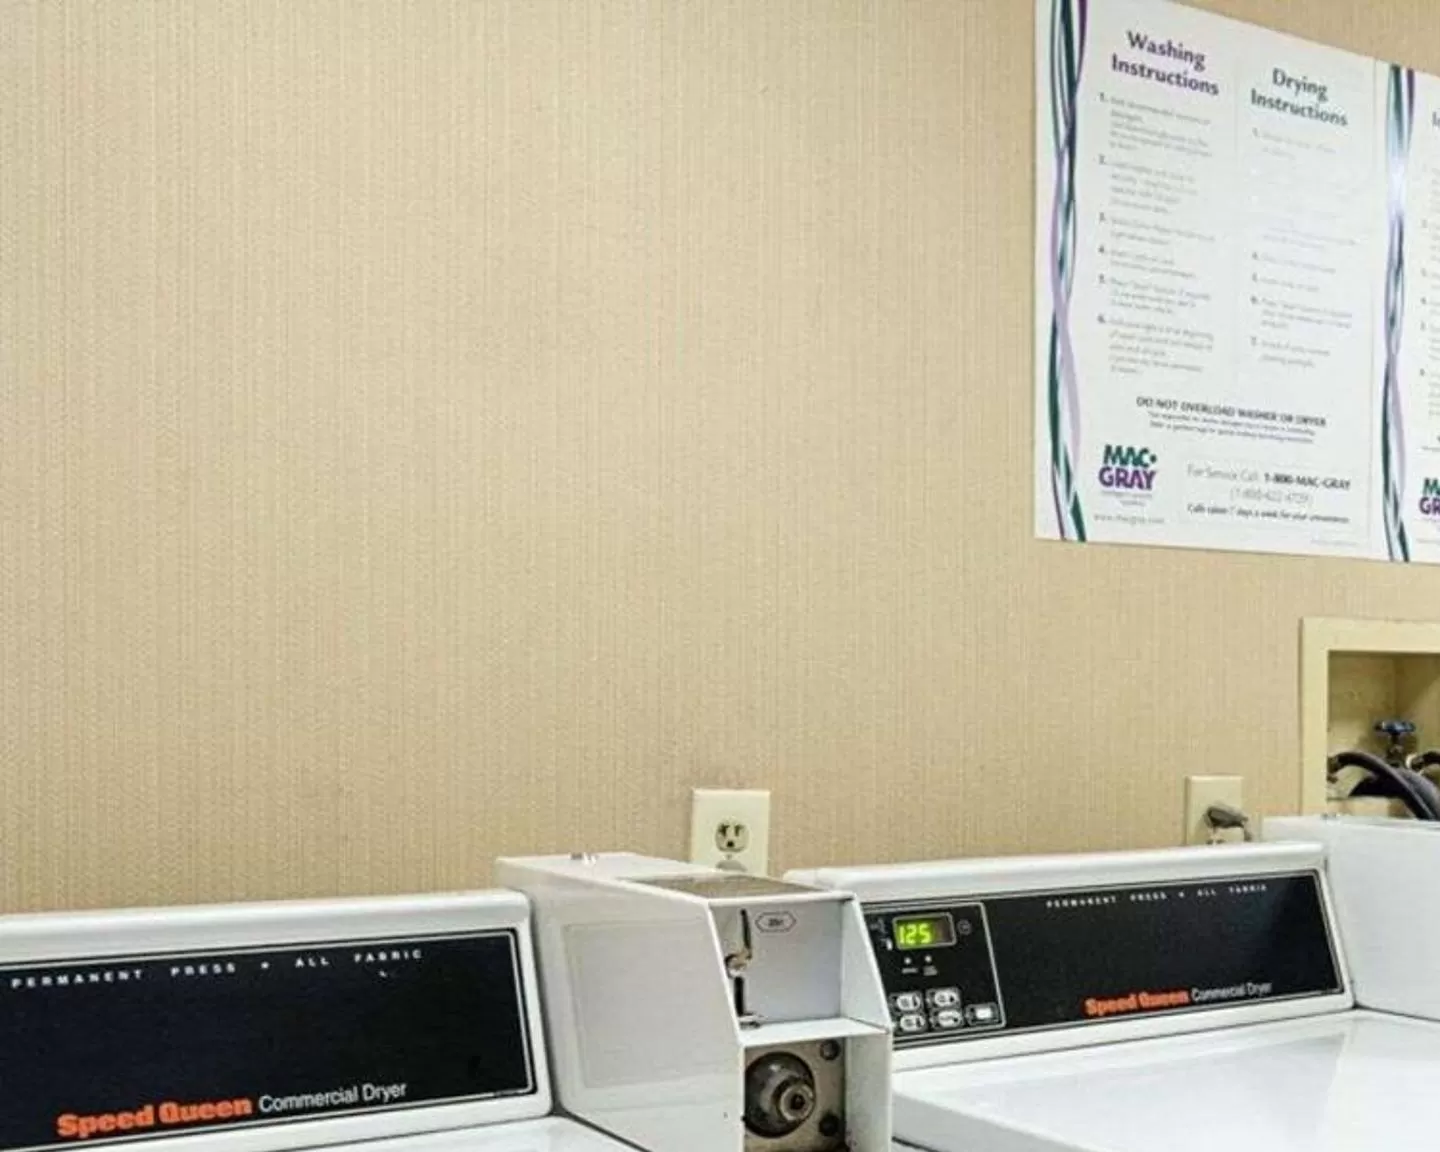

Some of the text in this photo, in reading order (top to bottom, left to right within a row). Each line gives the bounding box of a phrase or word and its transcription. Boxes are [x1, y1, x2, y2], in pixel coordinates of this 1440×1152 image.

[1127, 30, 1206, 72] Washing
[1111, 52, 1219, 96] Instructions
[1272, 67, 1328, 102] Drying
[1251, 88, 1348, 126] Instructions
[1098, 466, 1157, 490] GRAY
[899, 922, 933, 945] 125
[11, 949, 422, 989] PERMANENT PRESS ALL FABRIC
[1084, 991, 1138, 1016] Speed
[1139, 990, 1191, 1008] Queen
[56, 1082, 408, 1139] Speed Queen Commercial Dryer
